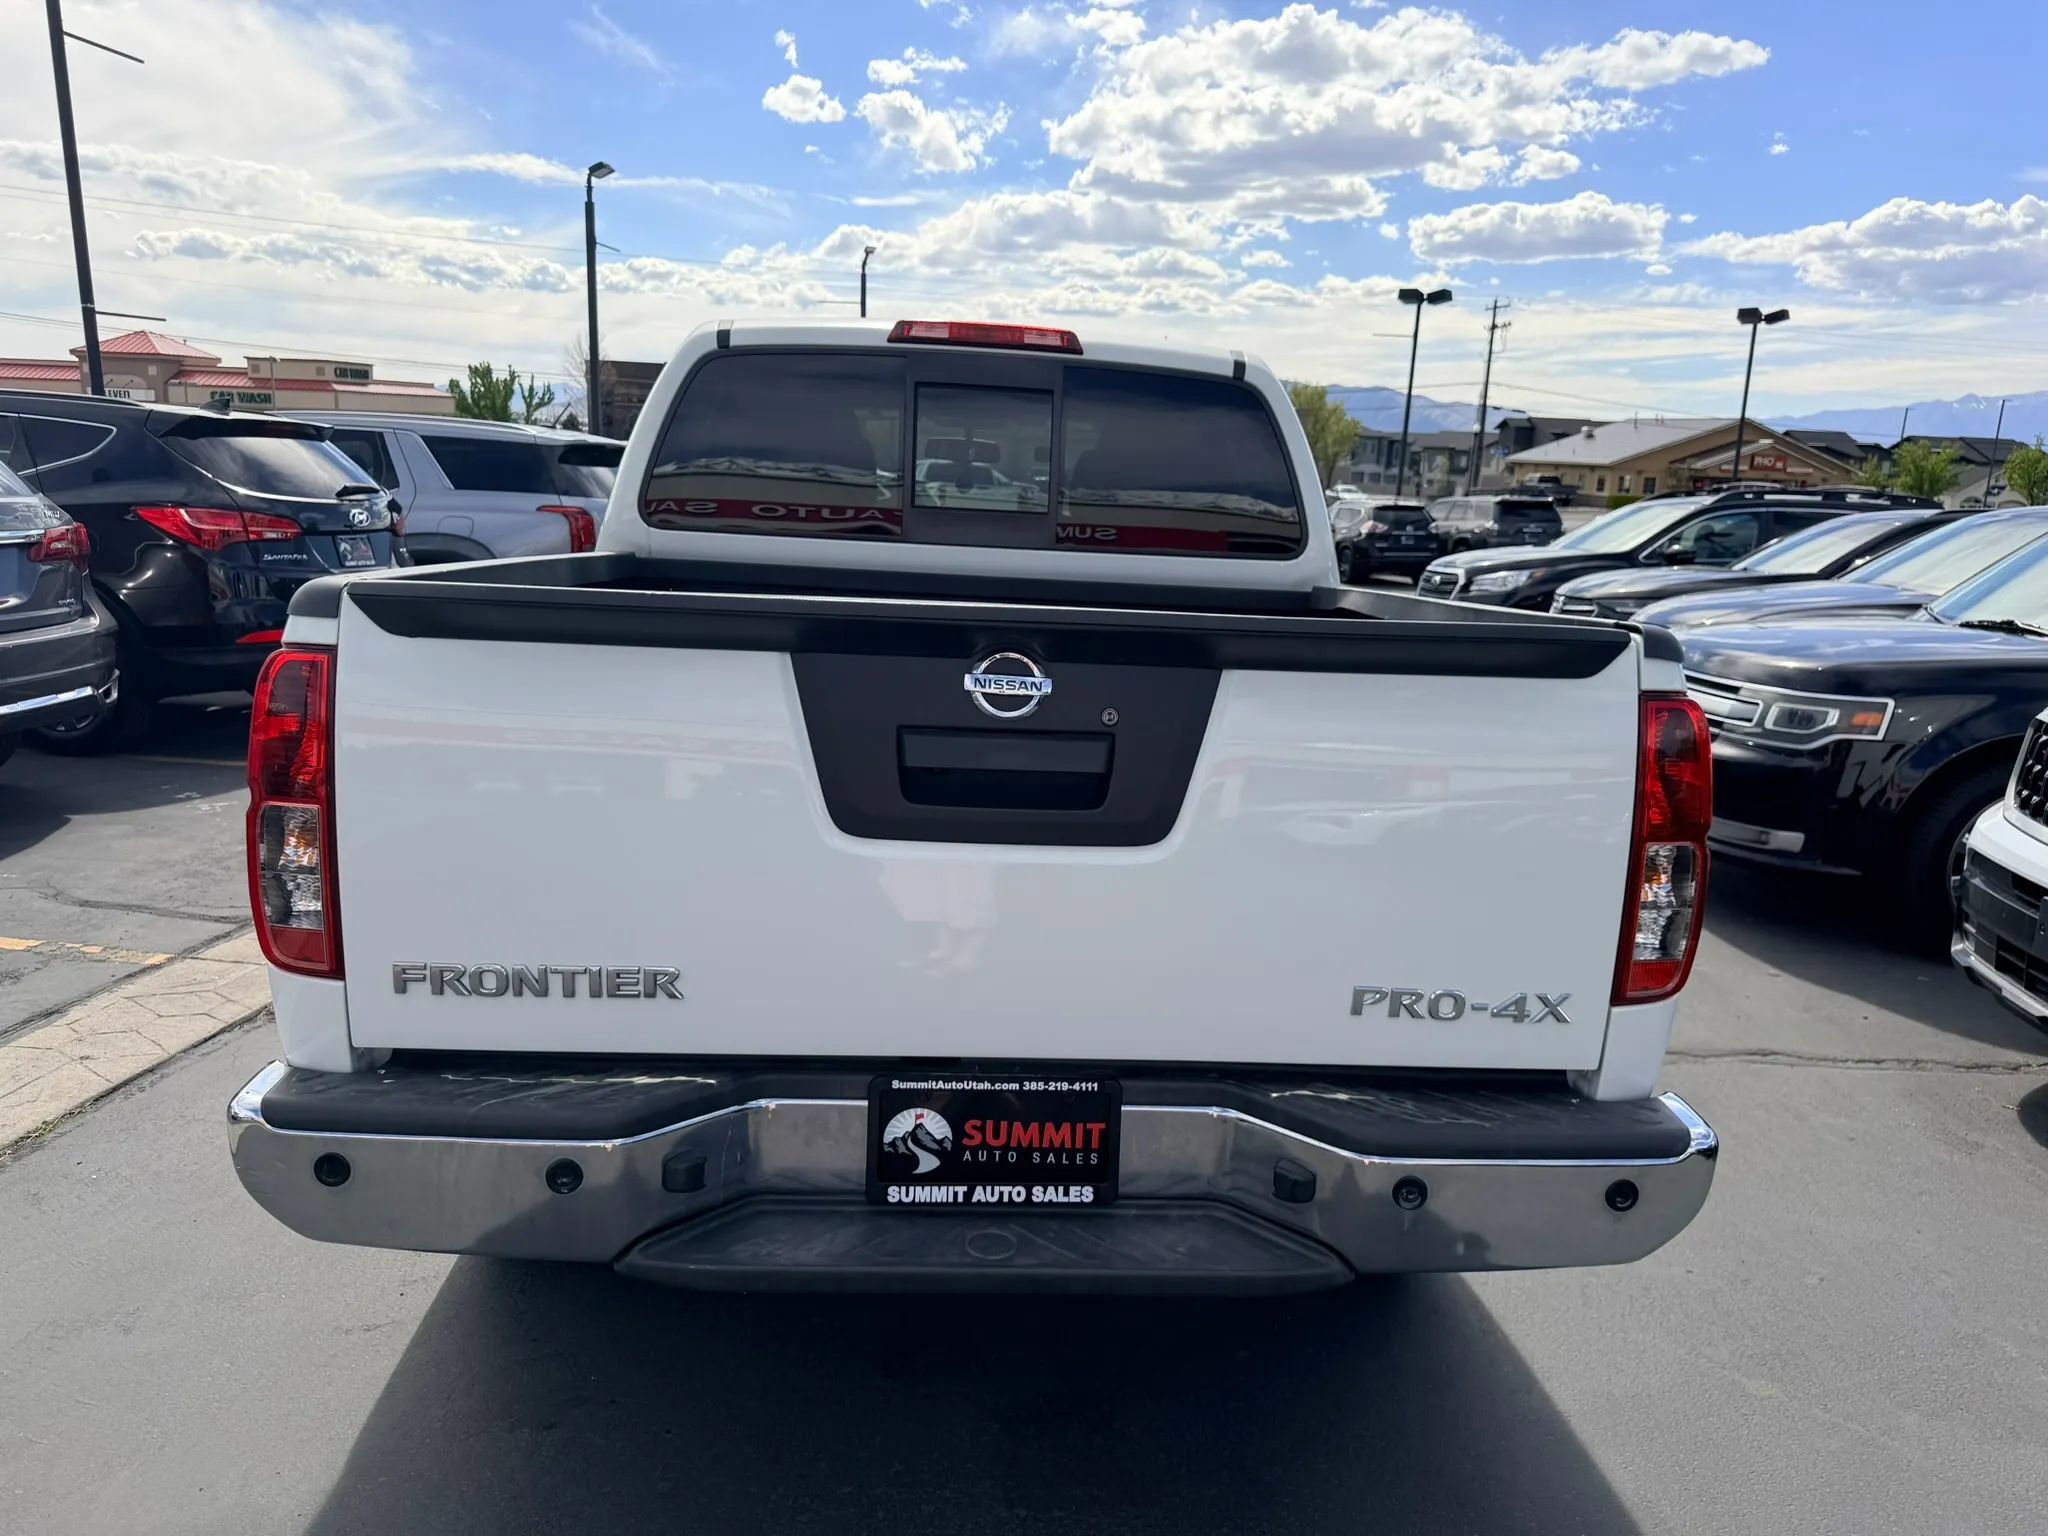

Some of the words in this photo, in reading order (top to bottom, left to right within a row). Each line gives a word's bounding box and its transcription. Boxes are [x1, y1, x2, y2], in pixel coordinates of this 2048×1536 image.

[237, 392, 272, 404] WASH
[974, 677, 1042, 692] NISSAN
[392, 960, 685, 1000] FRONTIER
[1350, 985, 1573, 1024] PRO-4X
[891, 1079, 1019, 1091] SummitAutoUtah.com
[1022, 1081, 1098, 1092] 385-219-4111
[961, 1119, 1106, 1149] SUMMIT
[963, 1150, 1017, 1162] AUTO
[1032, 1152, 1098, 1165] SALES
[887, 1186, 967, 1202] SUMMIT
[971, 1186, 1026, 1203] AUTO
[1031, 1186, 1094, 1203] SALES
